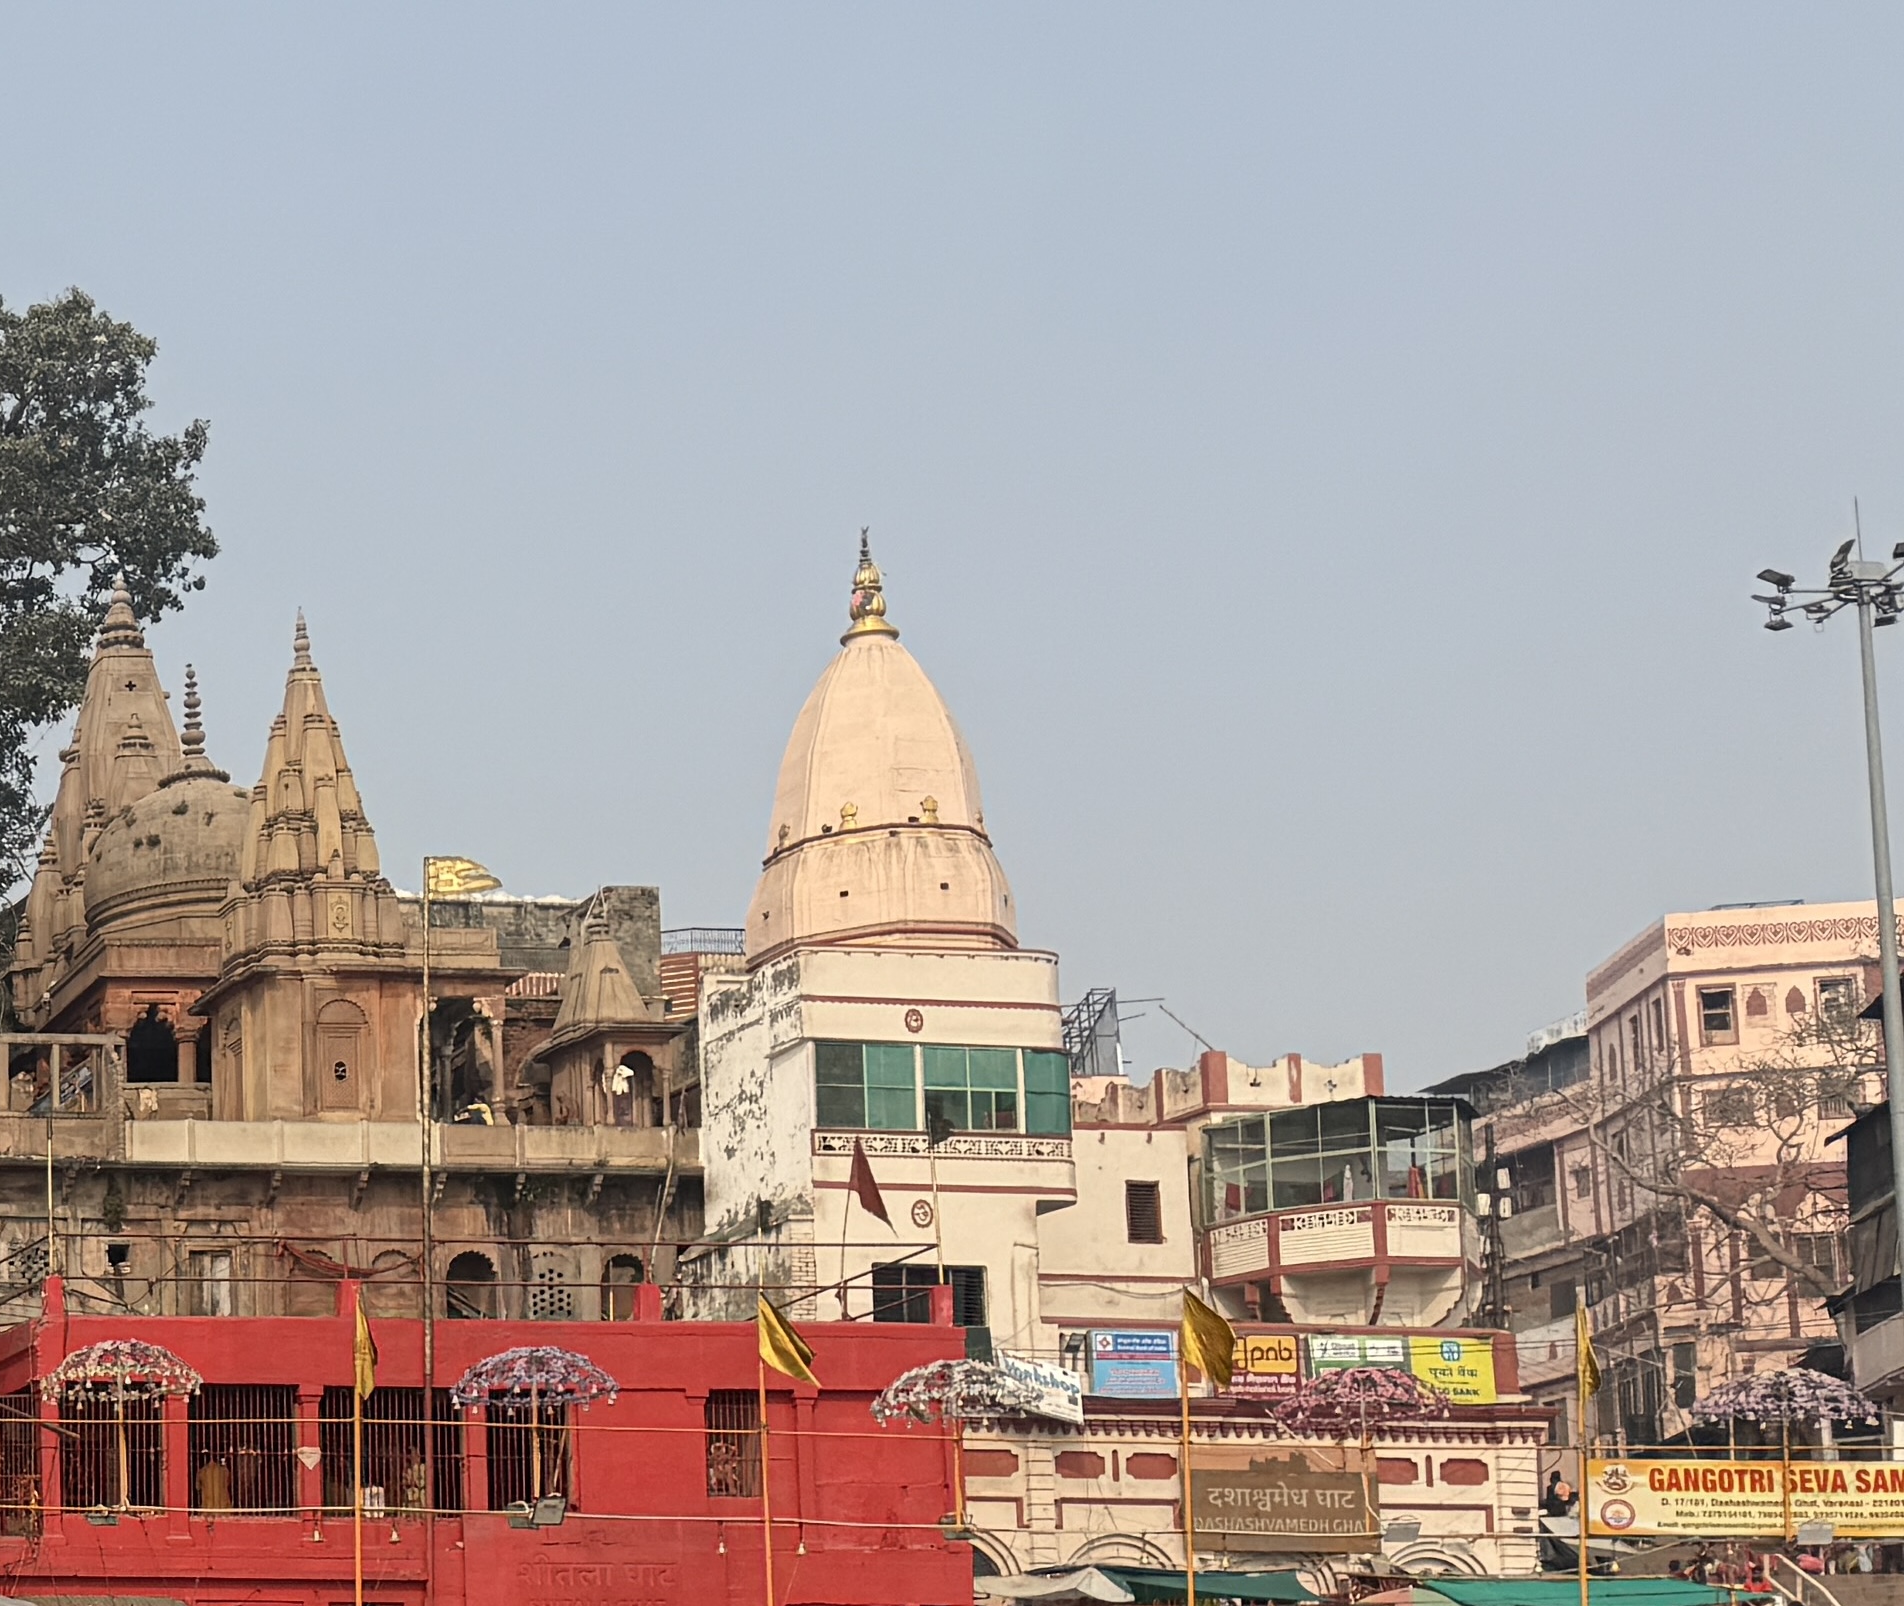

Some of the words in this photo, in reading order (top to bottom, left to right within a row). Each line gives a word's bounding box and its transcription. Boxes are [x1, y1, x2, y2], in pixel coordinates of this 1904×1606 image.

[1250, 1339, 1293, 1368] pnb
[1648, 1467, 1775, 1493] GANGOTRI
[1786, 1467, 1848, 1494] SEVA
[1206, 1480, 1310, 1512] दशाश्वमेध
[1314, 1488, 1356, 1509] घाट
[1711, 1498, 1789, 1508] Dashashwamed
[1193, 1516, 1330, 1533] DASHASHVAMEDH
[1332, 1518, 1367, 1533] GHA
[516, 1553, 616, 1587] शीतला
[622, 1562, 677, 1587] घाट
